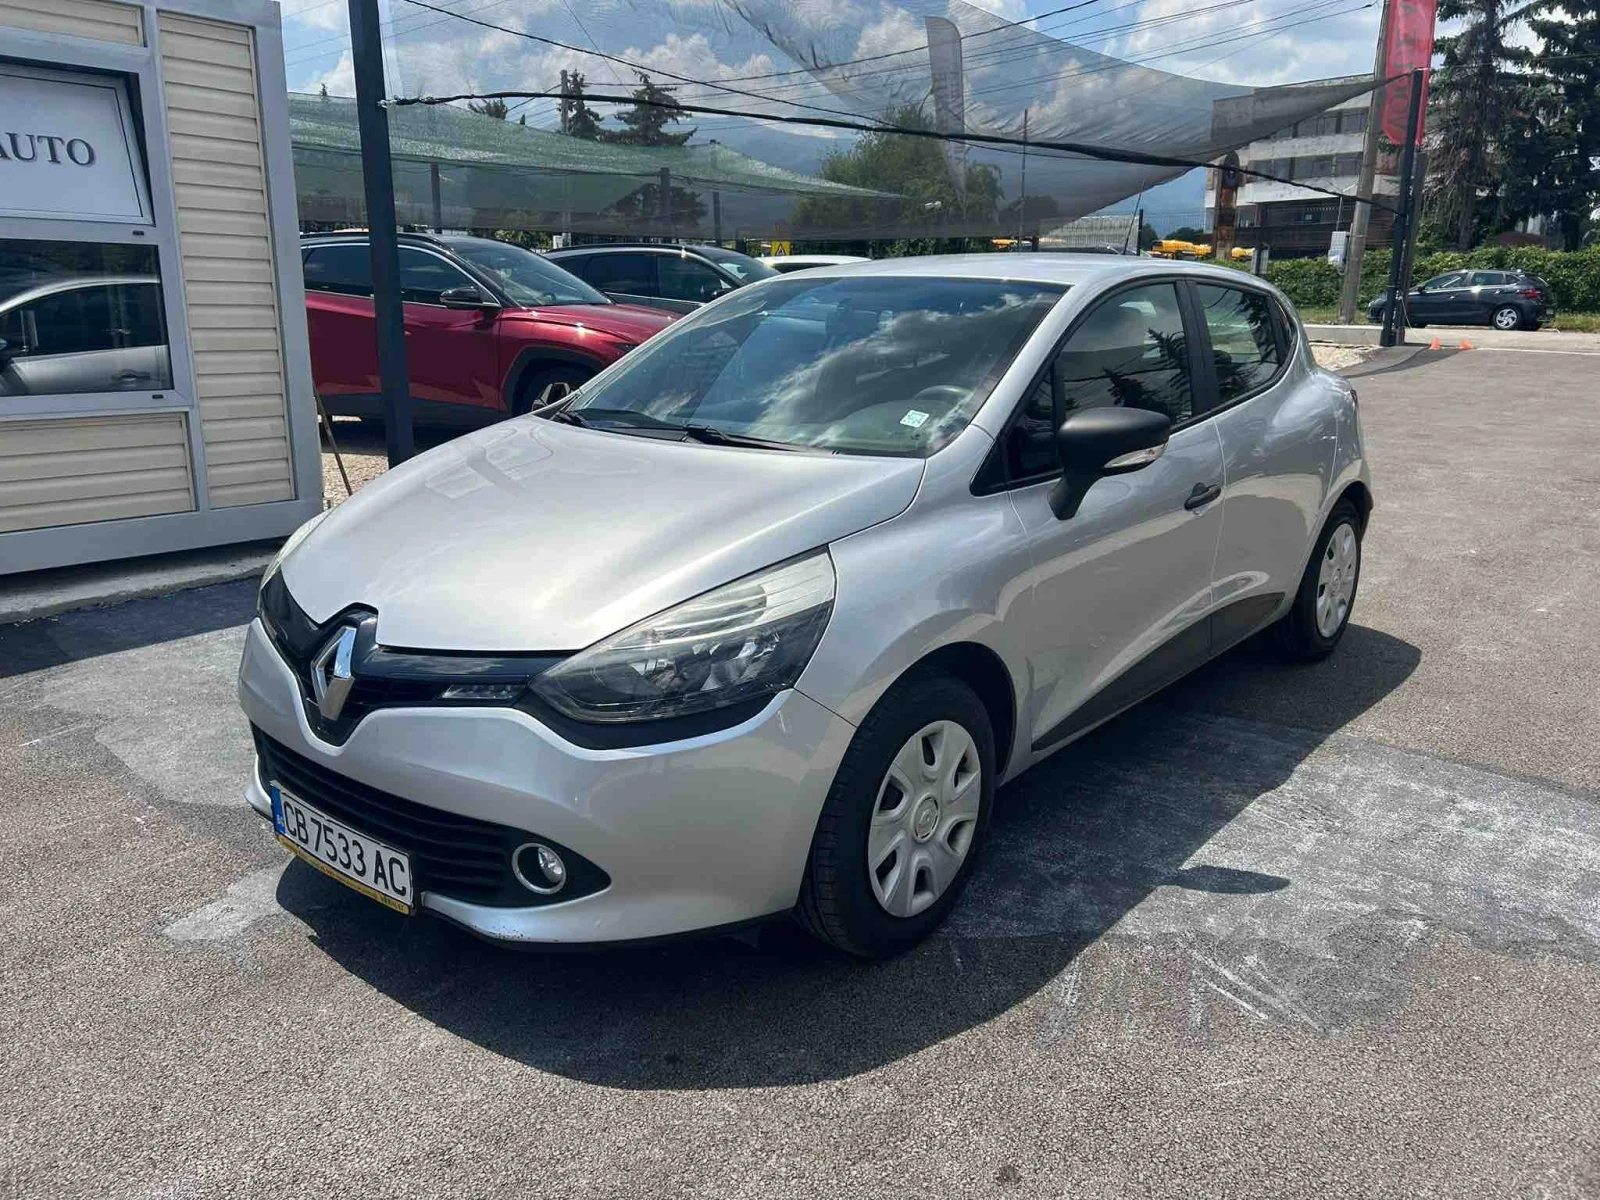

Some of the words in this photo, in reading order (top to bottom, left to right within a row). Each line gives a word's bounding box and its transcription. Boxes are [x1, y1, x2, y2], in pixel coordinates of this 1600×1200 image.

[283, 800, 309, 845] CB
[310, 817, 367, 877] 7533
[374, 850, 406, 896] AC
